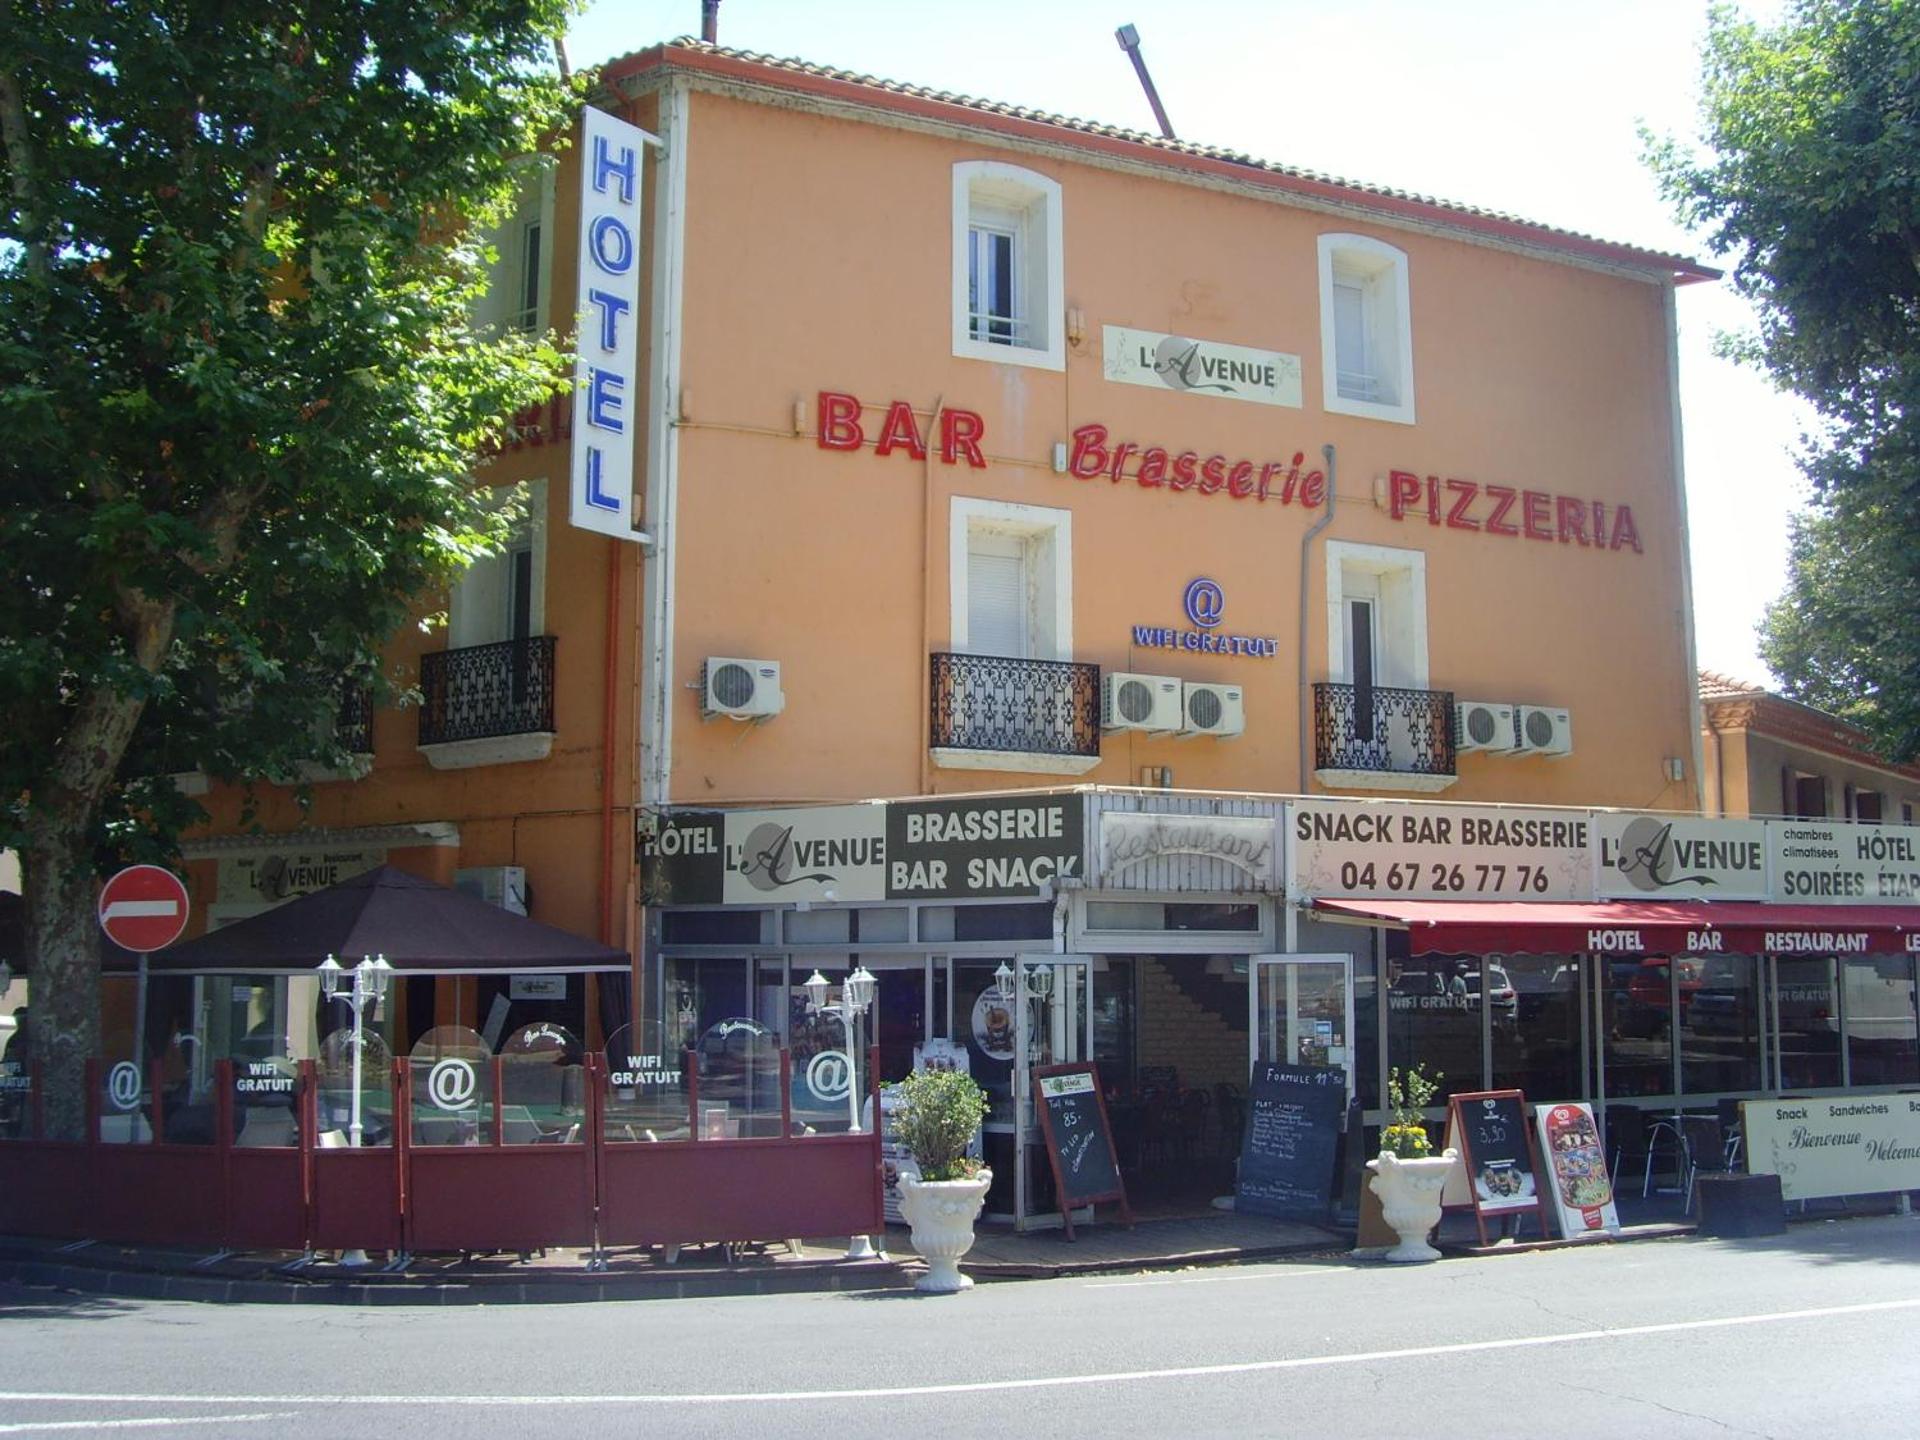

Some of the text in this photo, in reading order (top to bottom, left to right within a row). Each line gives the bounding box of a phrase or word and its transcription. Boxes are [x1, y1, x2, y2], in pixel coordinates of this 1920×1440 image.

[585, 133, 635, 514] HOTEL
[817, 390, 987, 470] BAR
[1068, 422, 1328, 509] Brasserie
[1388, 470, 1645, 555] PIZZERIA
[1132, 624, 1280, 658] WIFI GRATUIT
[907, 807, 1063, 843] BRASSERIE
[1296, 813, 1588, 850] SNACK BAR BRASSERIE
[1783, 828, 1834, 842] chambres
[1856, 828, 1916, 862] HÔTEL
[891, 855, 1078, 890] BAR SNACK
[1341, 861, 1549, 894] 04 67 26 77 76
[1783, 865, 1865, 897] SOIRÉES
[1588, 929, 1645, 951] HOTEL
[1686, 931, 1869, 952] BAR RESTAURANT
[1389, 995, 1474, 1010] WIFI GRATUIT
[249, 1063, 279, 1075] WIFI
[611, 1071, 682, 1086] GRATUIT
[627, 1055, 662, 1069] WIFI
[237, 1078, 294, 1092] GRATUIT
[1776, 1107, 1808, 1120] Snack
[1829, 1103, 1889, 1117] Sandwiches
[1788, 1126, 1920, 1162] Bienvenue Welcome
